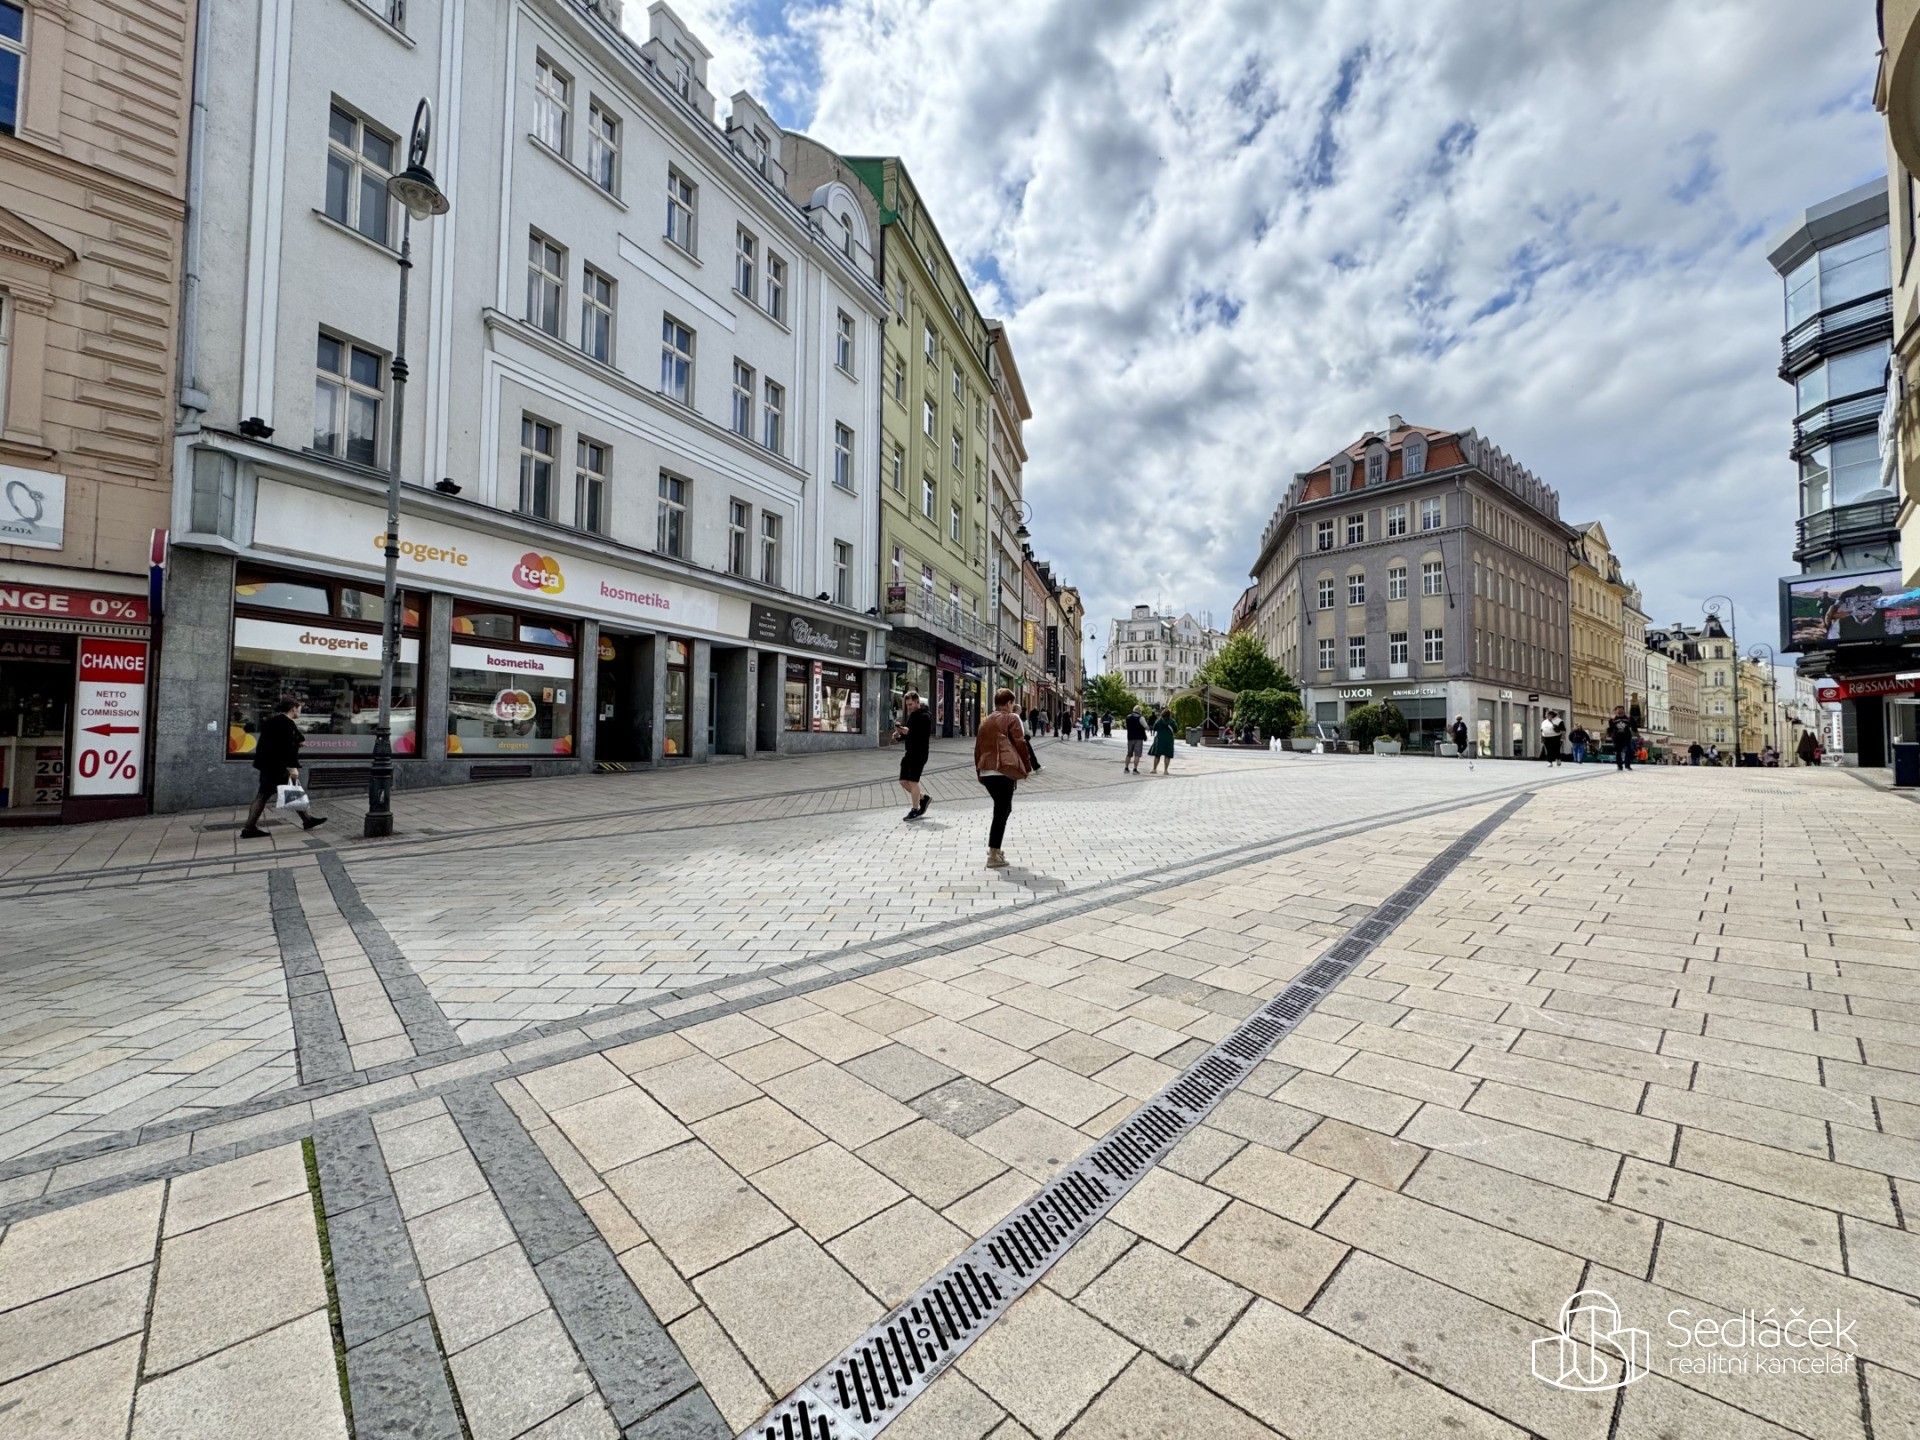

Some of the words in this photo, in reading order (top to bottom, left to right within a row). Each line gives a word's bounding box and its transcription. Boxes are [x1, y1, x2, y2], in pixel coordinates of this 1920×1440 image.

[373, 531, 468, 567] dogerie
[519, 565, 560, 588] teta
[600, 581, 670, 609] kosmetika
[90, 598, 137, 618] 0%
[299, 631, 368, 650] drogerie
[81, 653, 144, 671] CHANGE
[487, 655, 544, 671] kosmetika
[1339, 688, 1373, 698] LUXOR
[1849, 680, 1915, 694] ROSSMANN
[81, 709, 139, 717] COMMISSION
[501, 702, 529, 713] teta
[79, 749, 137, 779] 0%
